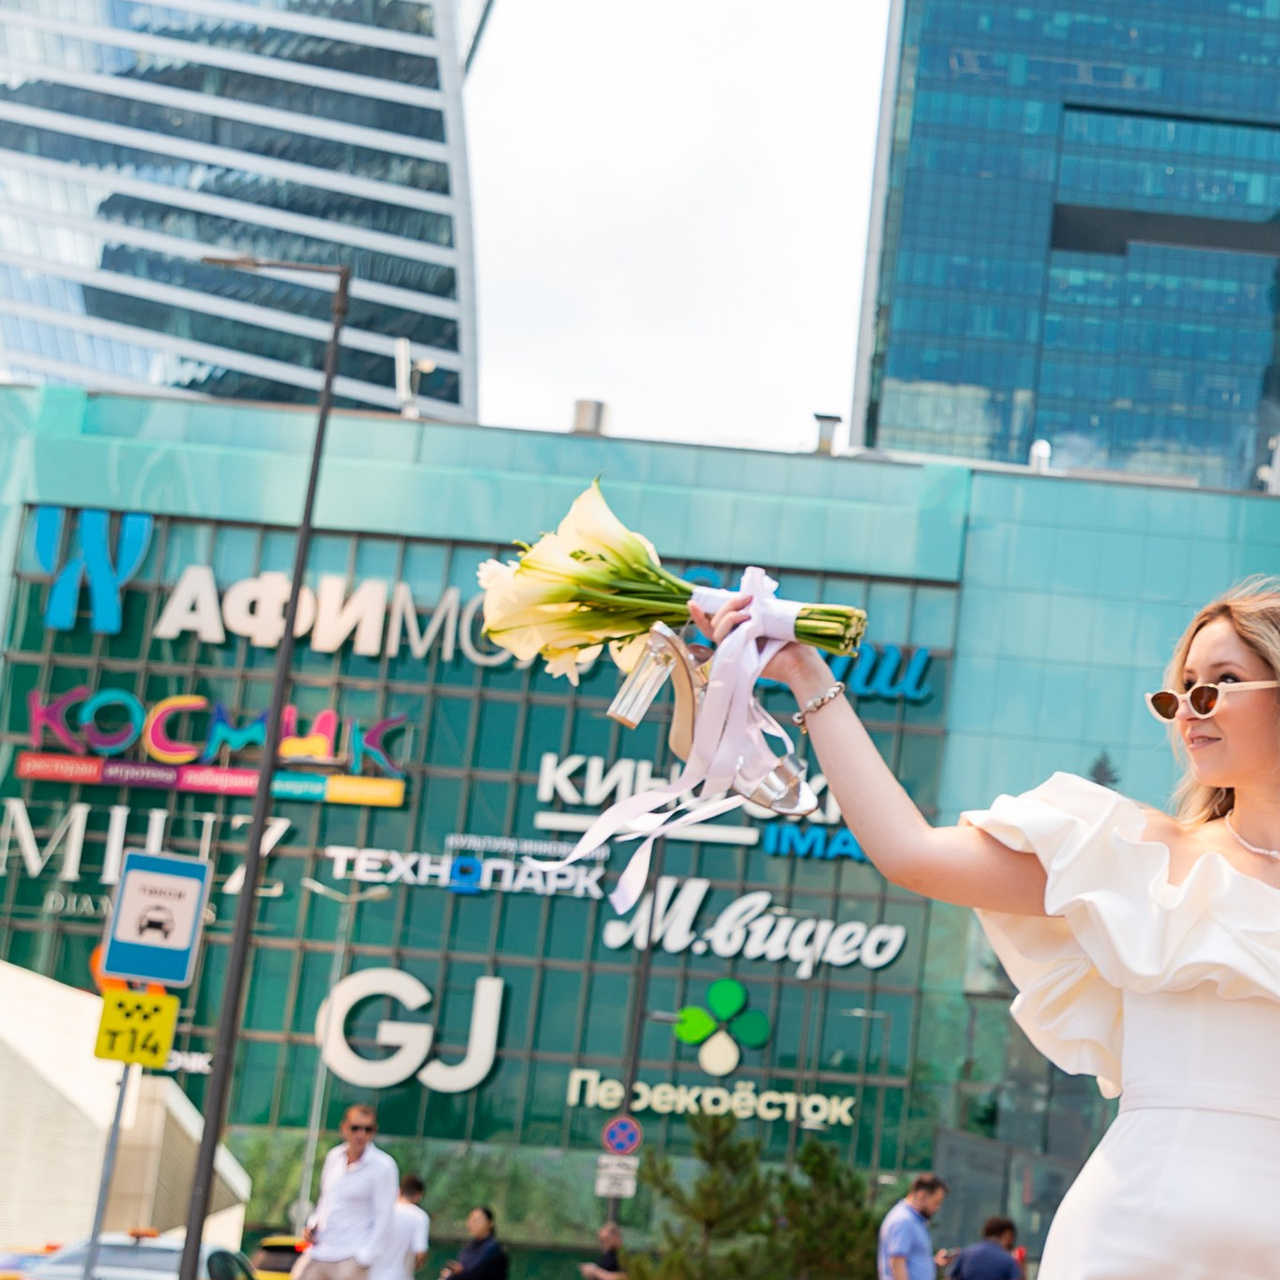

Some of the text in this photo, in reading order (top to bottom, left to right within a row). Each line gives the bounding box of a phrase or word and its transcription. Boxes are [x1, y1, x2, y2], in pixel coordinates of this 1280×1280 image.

[153, 565, 600, 672] АФИМО
[324, 845, 605, 900] ТЕХНОПАРК
[764, 824, 873, 862] IMA
[314, 967, 505, 1094] GJ
